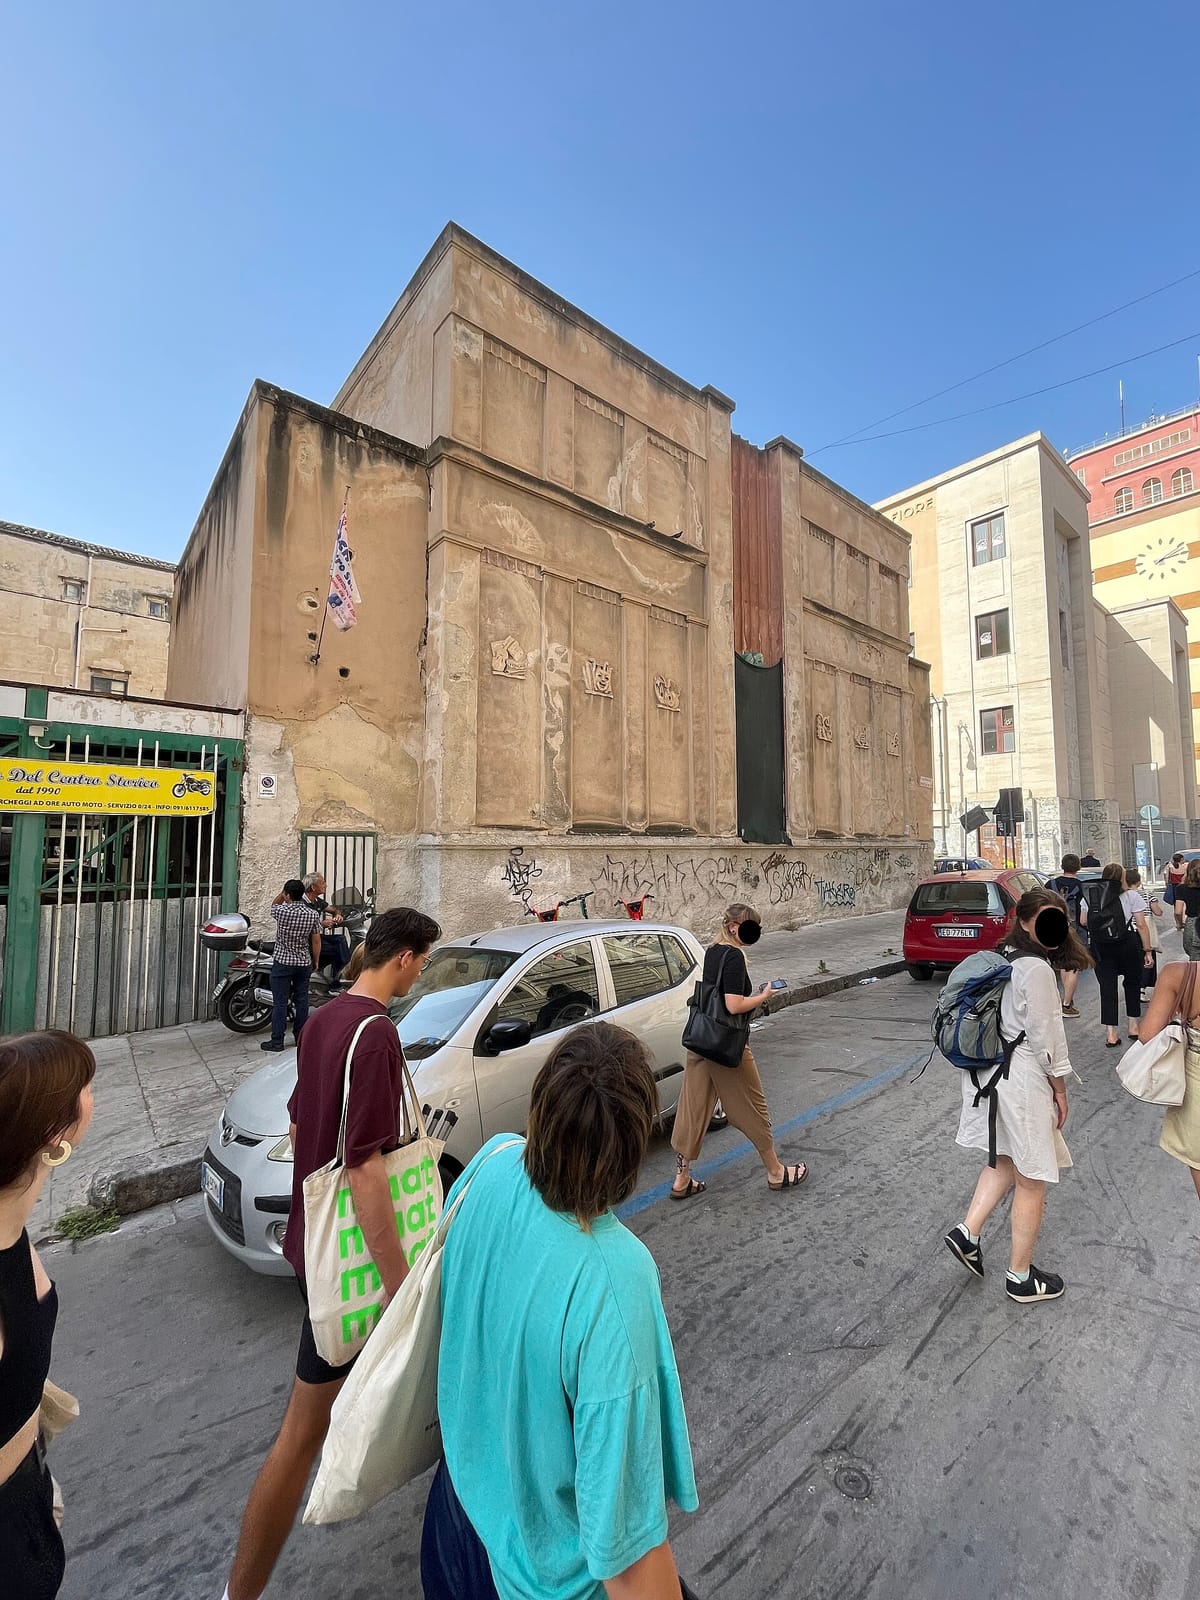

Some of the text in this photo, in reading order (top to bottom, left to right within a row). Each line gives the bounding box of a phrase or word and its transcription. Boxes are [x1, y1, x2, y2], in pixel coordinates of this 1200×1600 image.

[7, 767, 160, 789] Del Centro Storico
[15, 786, 61, 795] dal 1990
